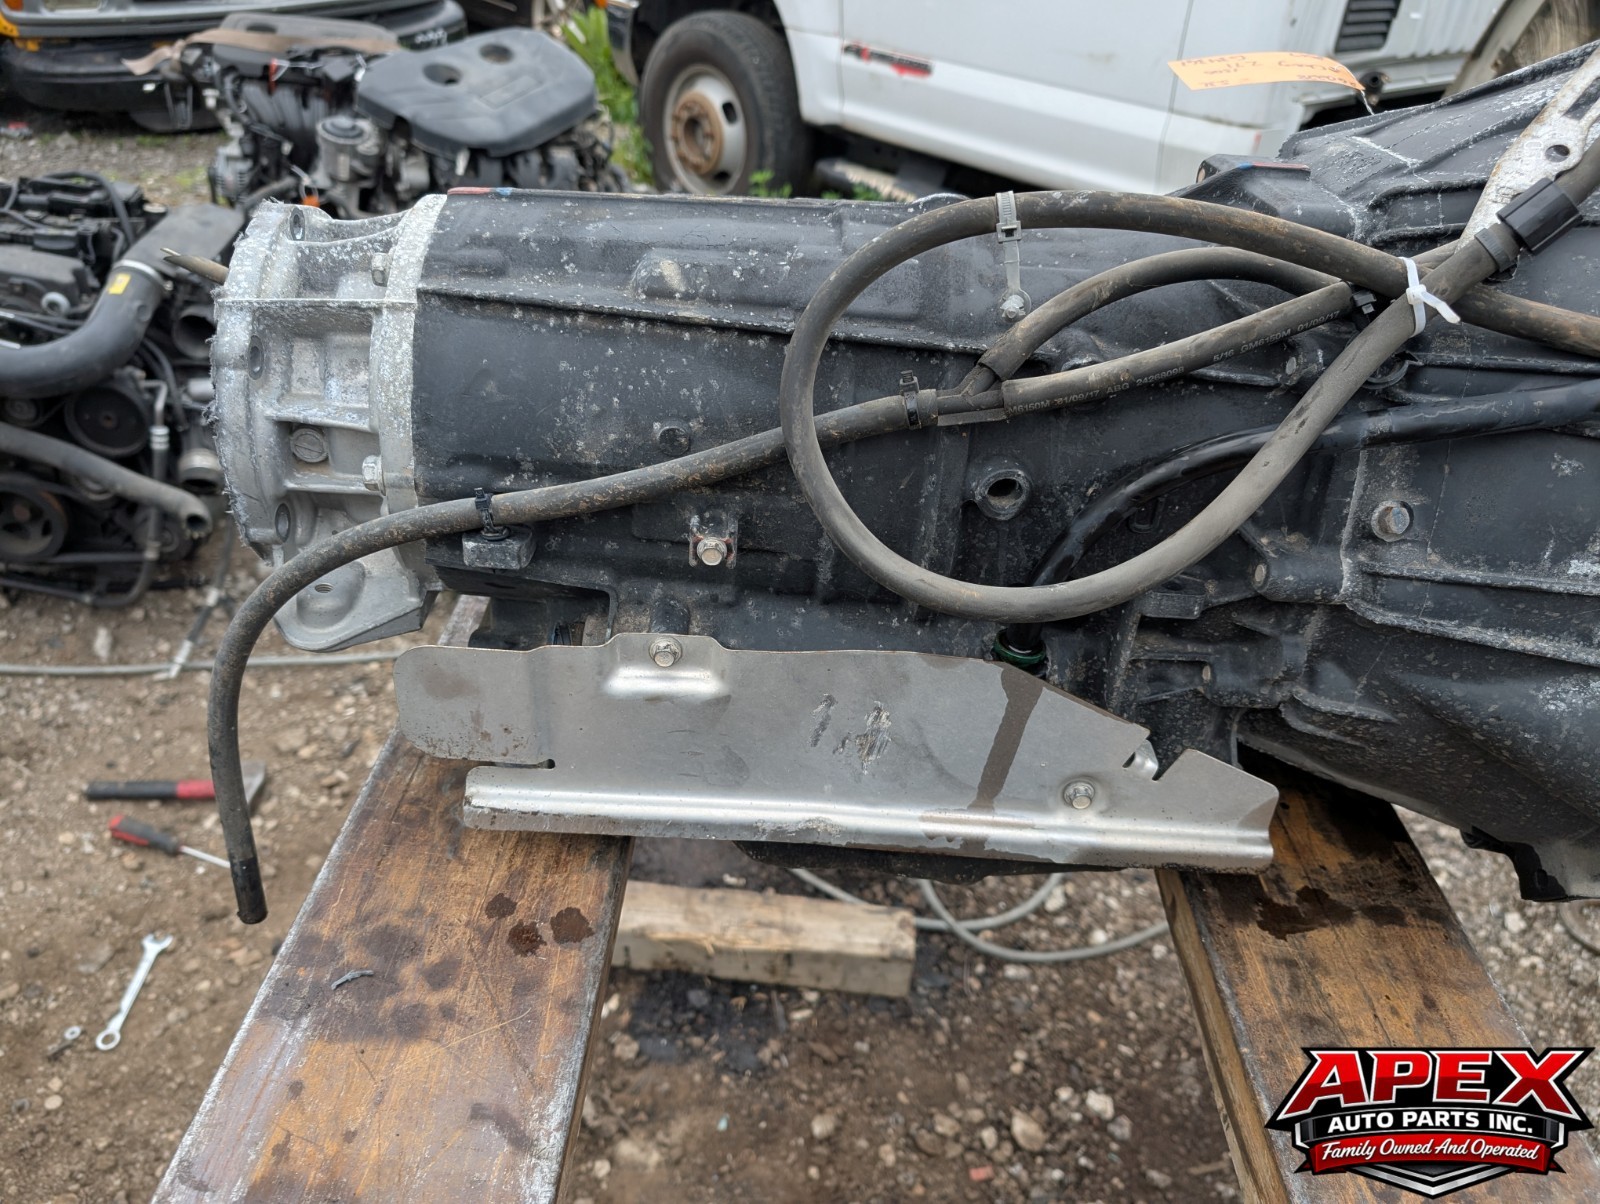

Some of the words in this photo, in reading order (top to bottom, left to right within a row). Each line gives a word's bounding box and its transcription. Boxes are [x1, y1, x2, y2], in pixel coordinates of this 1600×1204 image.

[1007, 399, 1050, 415] M6150M
[1213, 348, 1234, 362] 5/16
[1240, 328, 1292, 354] GM6150M
